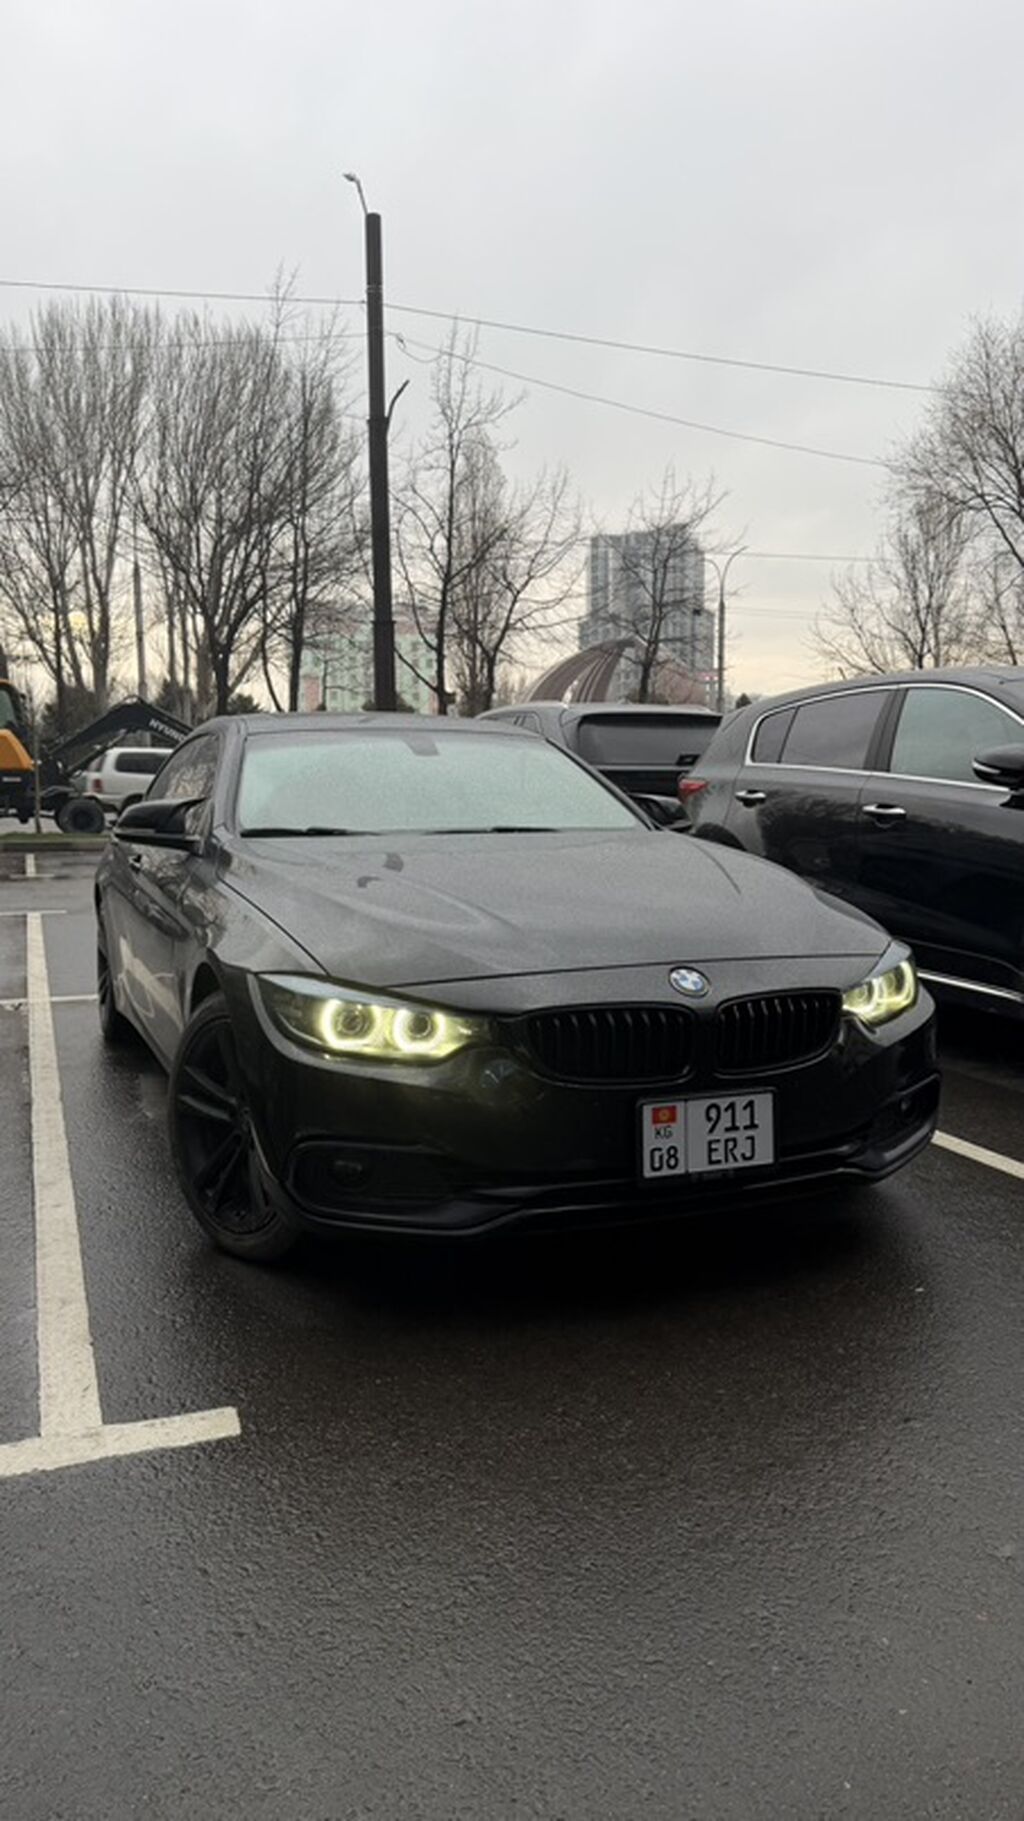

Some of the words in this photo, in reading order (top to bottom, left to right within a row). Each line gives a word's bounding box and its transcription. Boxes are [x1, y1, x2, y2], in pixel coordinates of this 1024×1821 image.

[705, 1100, 759, 1134] 911
[654, 1125, 673, 1139] KG
[650, 1146, 679, 1172] 08
[707, 1136, 755, 1165] ERJ
